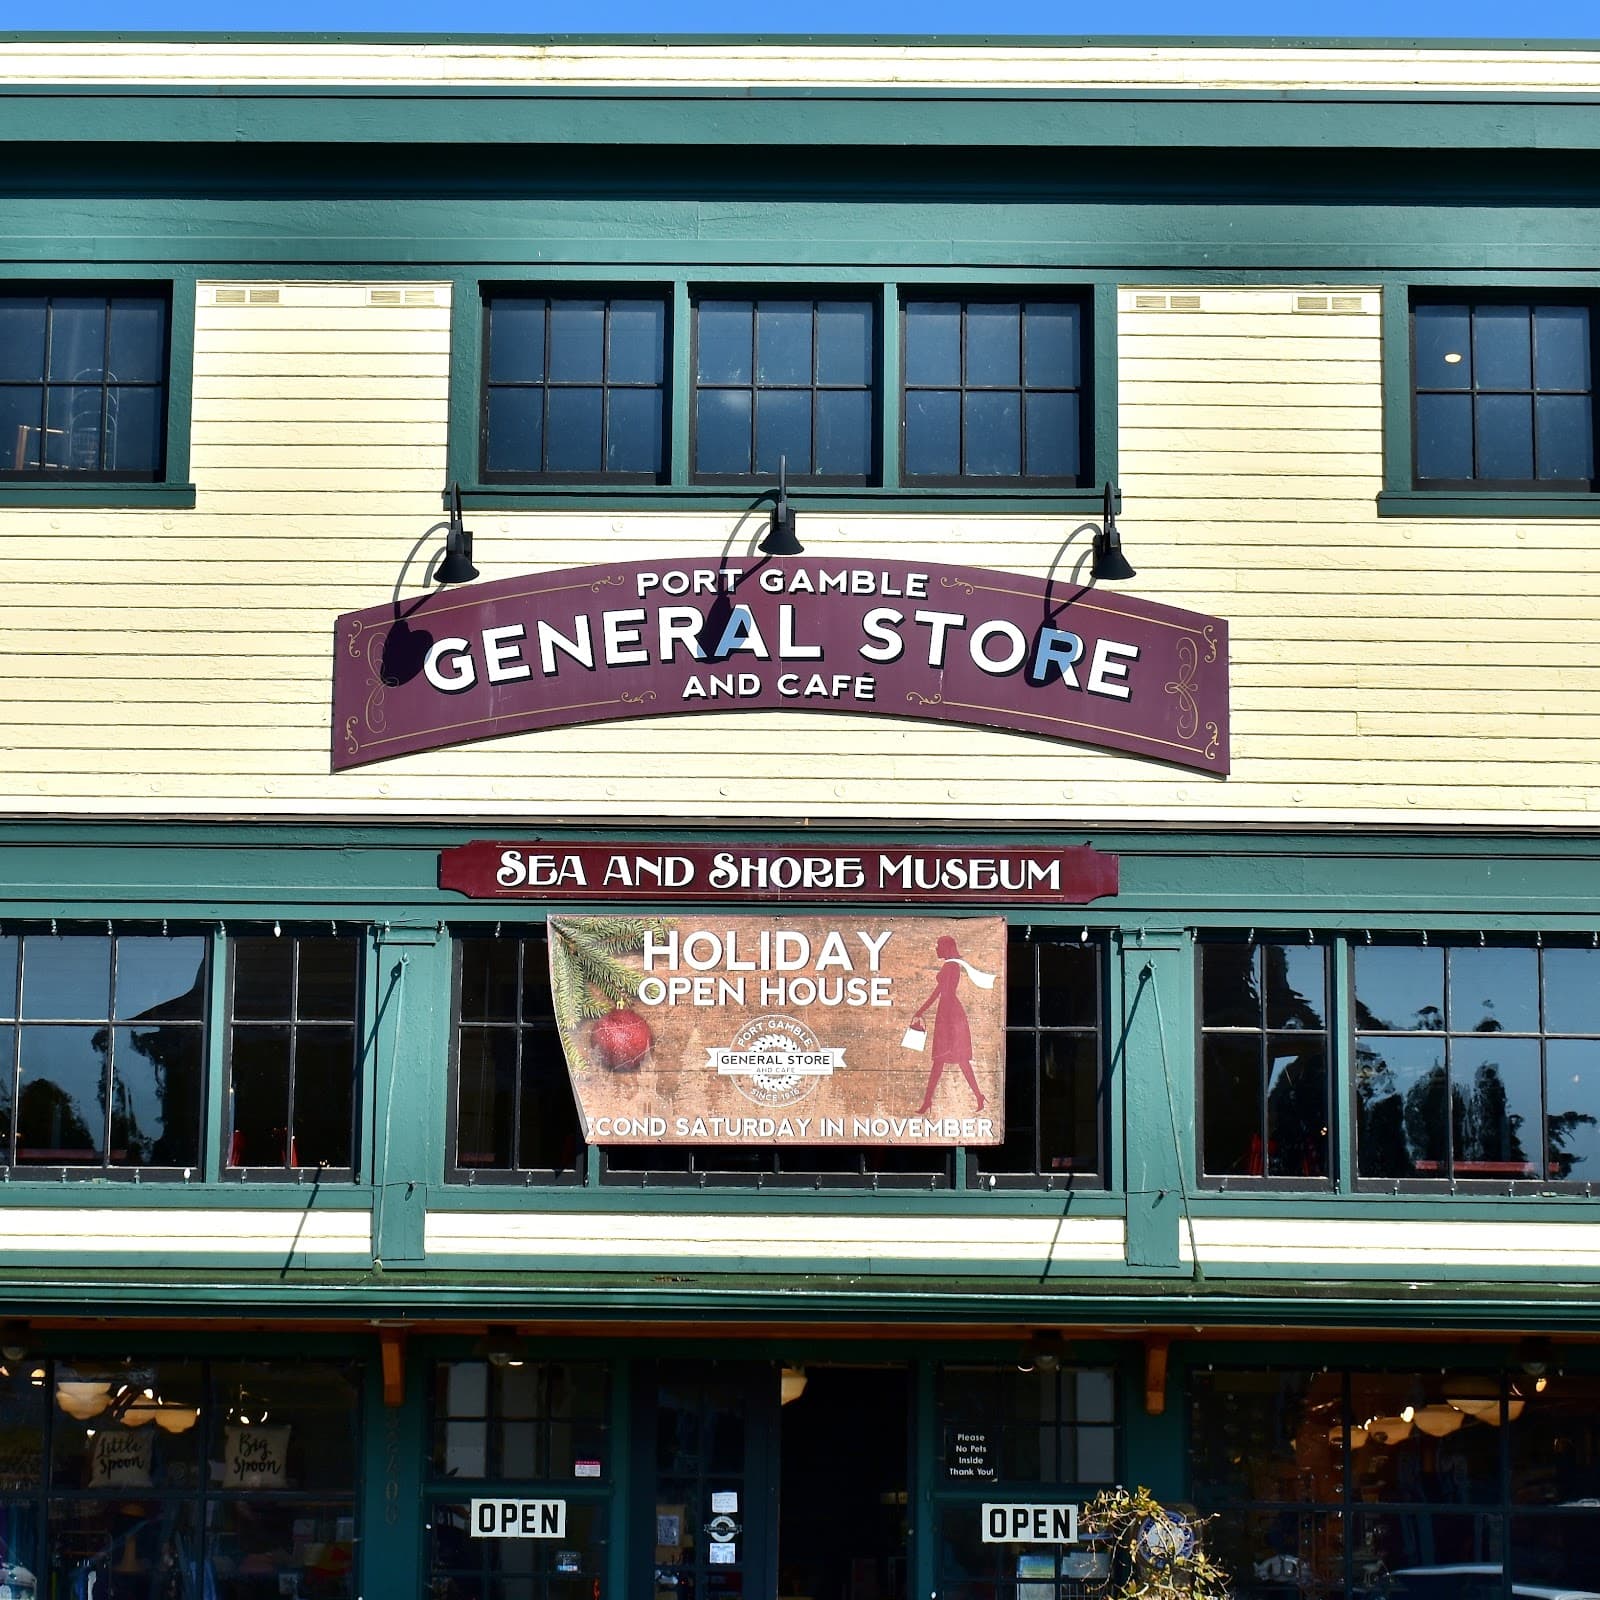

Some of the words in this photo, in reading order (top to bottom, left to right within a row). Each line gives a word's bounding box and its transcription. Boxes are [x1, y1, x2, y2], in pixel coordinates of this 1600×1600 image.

[636, 569, 743, 597] PORT
[759, 569, 929, 597] GAMBLE
[423, 603, 822, 694] GENERAL
[859, 606, 1140, 700] STORE
[682, 673, 763, 699] AND
[496, 850, 588, 888] SEA
[602, 855, 695, 888] AND
[708, 852, 865, 890] SHORE
[878, 854, 1061, 890] MUSEUM
[642, 930, 894, 972] HOLIDAY
[638, 977, 745, 1006] OPEN
[760, 977, 894, 1007] HOUSE
[737, 1021, 764, 1048] PORT
[767, 1020, 814, 1048] GAMBLE
[721, 1055, 783, 1065] GENERAL
[787, 1055, 831, 1065] STORE
[751, 1088, 778, 1101] SINCE
[675, 1117, 812, 1137] SATURDAY
[820, 1118, 845, 1137] IN
[853, 1118, 994, 1138] NOVEMBER
[239, 1432, 272, 1460] Big
[956, 1445, 968, 1453] No
[970, 1445, 987, 1453] Pets
[957, 1433, 985, 1441] Please
[949, 1467, 975, 1476] Thank
[976, 1467, 994, 1476] You!
[958, 1456, 984, 1465] Inside
[478, 1503, 559, 1534] OPEN
[989, 1508, 1070, 1539] OPEN
